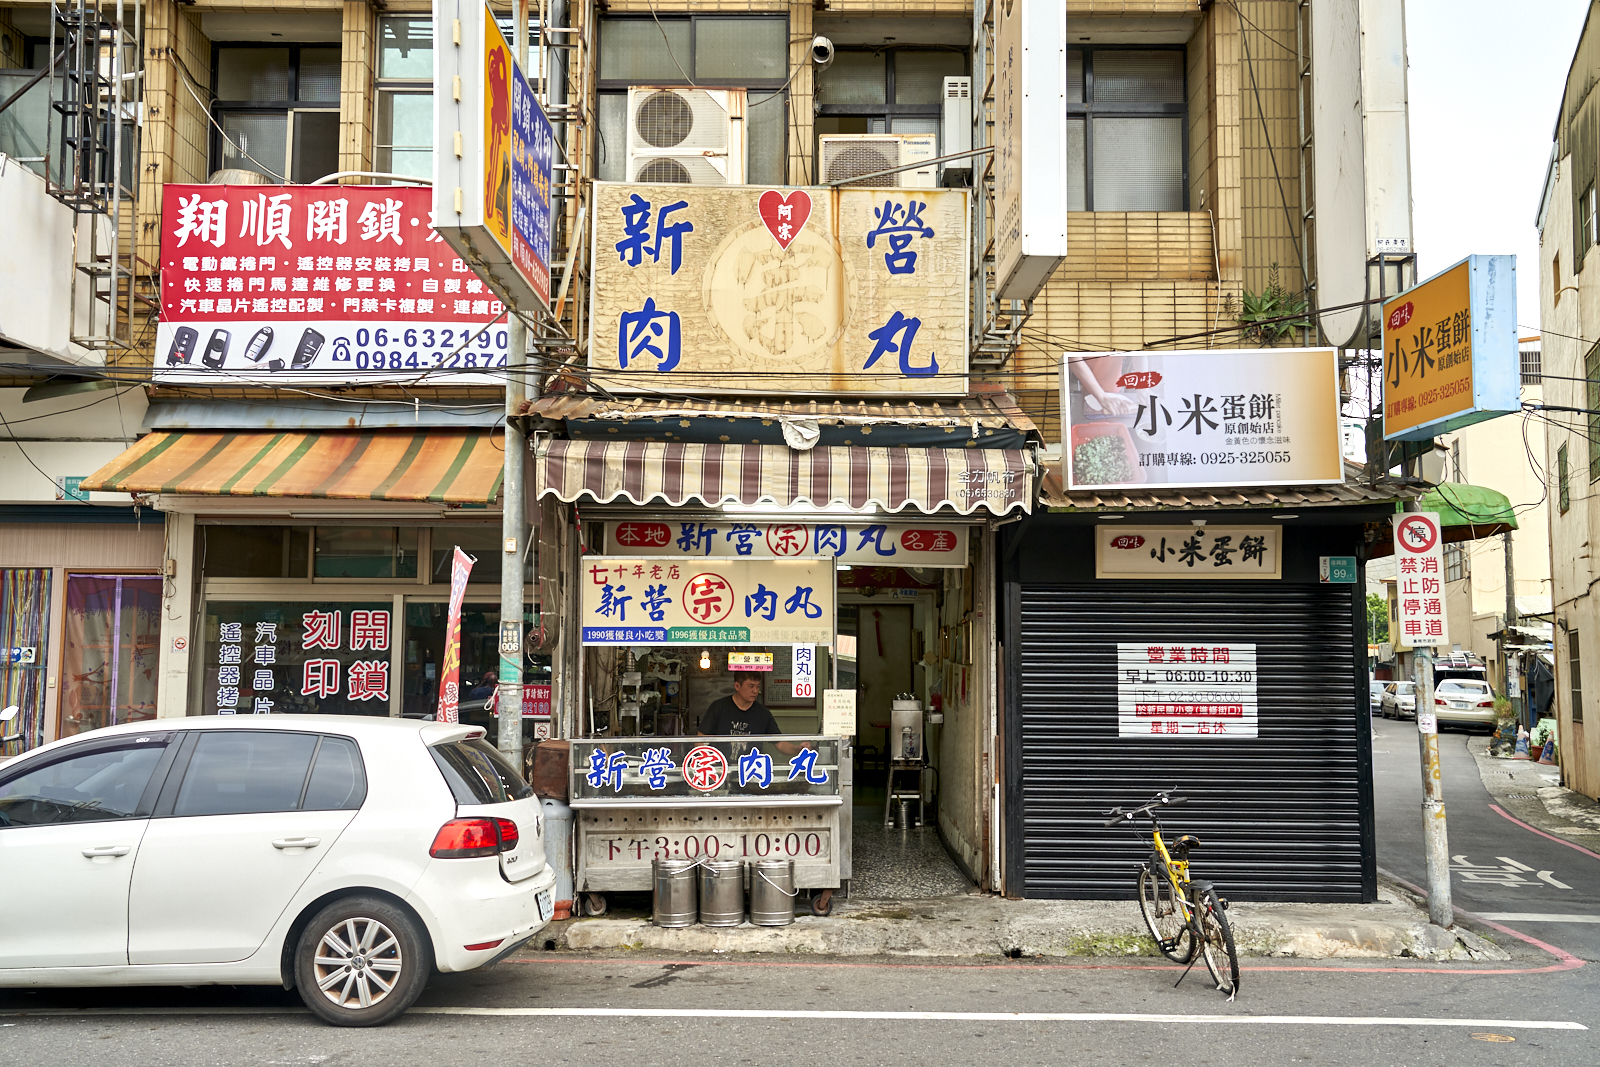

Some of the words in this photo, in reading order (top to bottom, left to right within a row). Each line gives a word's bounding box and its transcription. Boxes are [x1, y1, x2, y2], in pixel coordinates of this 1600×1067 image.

[173, 192, 404, 249] 翔順開鎖
[776, 203, 794, 241] 阿宗
[182, 256, 276, 272] 電動鐵捲門
[297, 256, 430, 273] 遙控器安裝拷貝
[184, 276, 396, 293] 快速捲門馬達維修更換
[423, 278, 493, 294] 自製橡
[179, 297, 324, 314] 汽車晶片遙控配製
[343, 298, 434, 314] 門禁卡複製
[1391, 303, 1411, 327] 回味
[1386, 308, 1471, 389] 小米蛋餅
[1437, 346, 1470, 373] 原創始店
[1123, 373, 1156, 388] 回味
[1418, 376, 1471, 408] 0925-325055
[1133, 393, 1276, 436] 小米蛋餅
[1224, 421, 1275, 435] 原創始店
[1225, 436, 1291, 446] 金黃色の懷念滋味
[1200, 450, 1291, 466] 0925-325055
[71, 487, 84, 497] 95
[619, 526, 667, 544] 本地
[676, 522, 763, 557] 新營
[813, 524, 897, 557] 肉丸
[903, 531, 951, 551] 名產
[1117, 536, 1140, 548] 回味
[1408, 525, 1427, 543] 停
[1149, 534, 1269, 568] 小米蛋餅
[589, 564, 681, 585] 七十年老店
[1333, 568, 1347, 579] 99
[595, 584, 673, 622] 新營
[744, 583, 823, 622] 肉丸
[1399, 556, 1422, 636] 禁止停車
[1420, 556, 1443, 636] 消防通道
[300, 609, 341, 700] 刻印
[348, 609, 390, 702] 開鎖
[501, 642, 520, 651] 006
[1147, 646, 1230, 664] 營業時間
[253, 621, 277, 714] 汽車晶片
[795, 647, 812, 676] 肉丸
[1126, 669, 1157, 684] 早上
[1165, 670, 1252, 683] 06:00-10:30
[795, 683, 812, 697] 60
[1139, 689, 1165, 702] 下午
[1169, 690, 1241, 703] 02:30-06:00
[1150, 720, 1227, 735] 星期一店休
[586, 747, 676, 792] 新營
[738, 747, 829, 789] 肉丸
